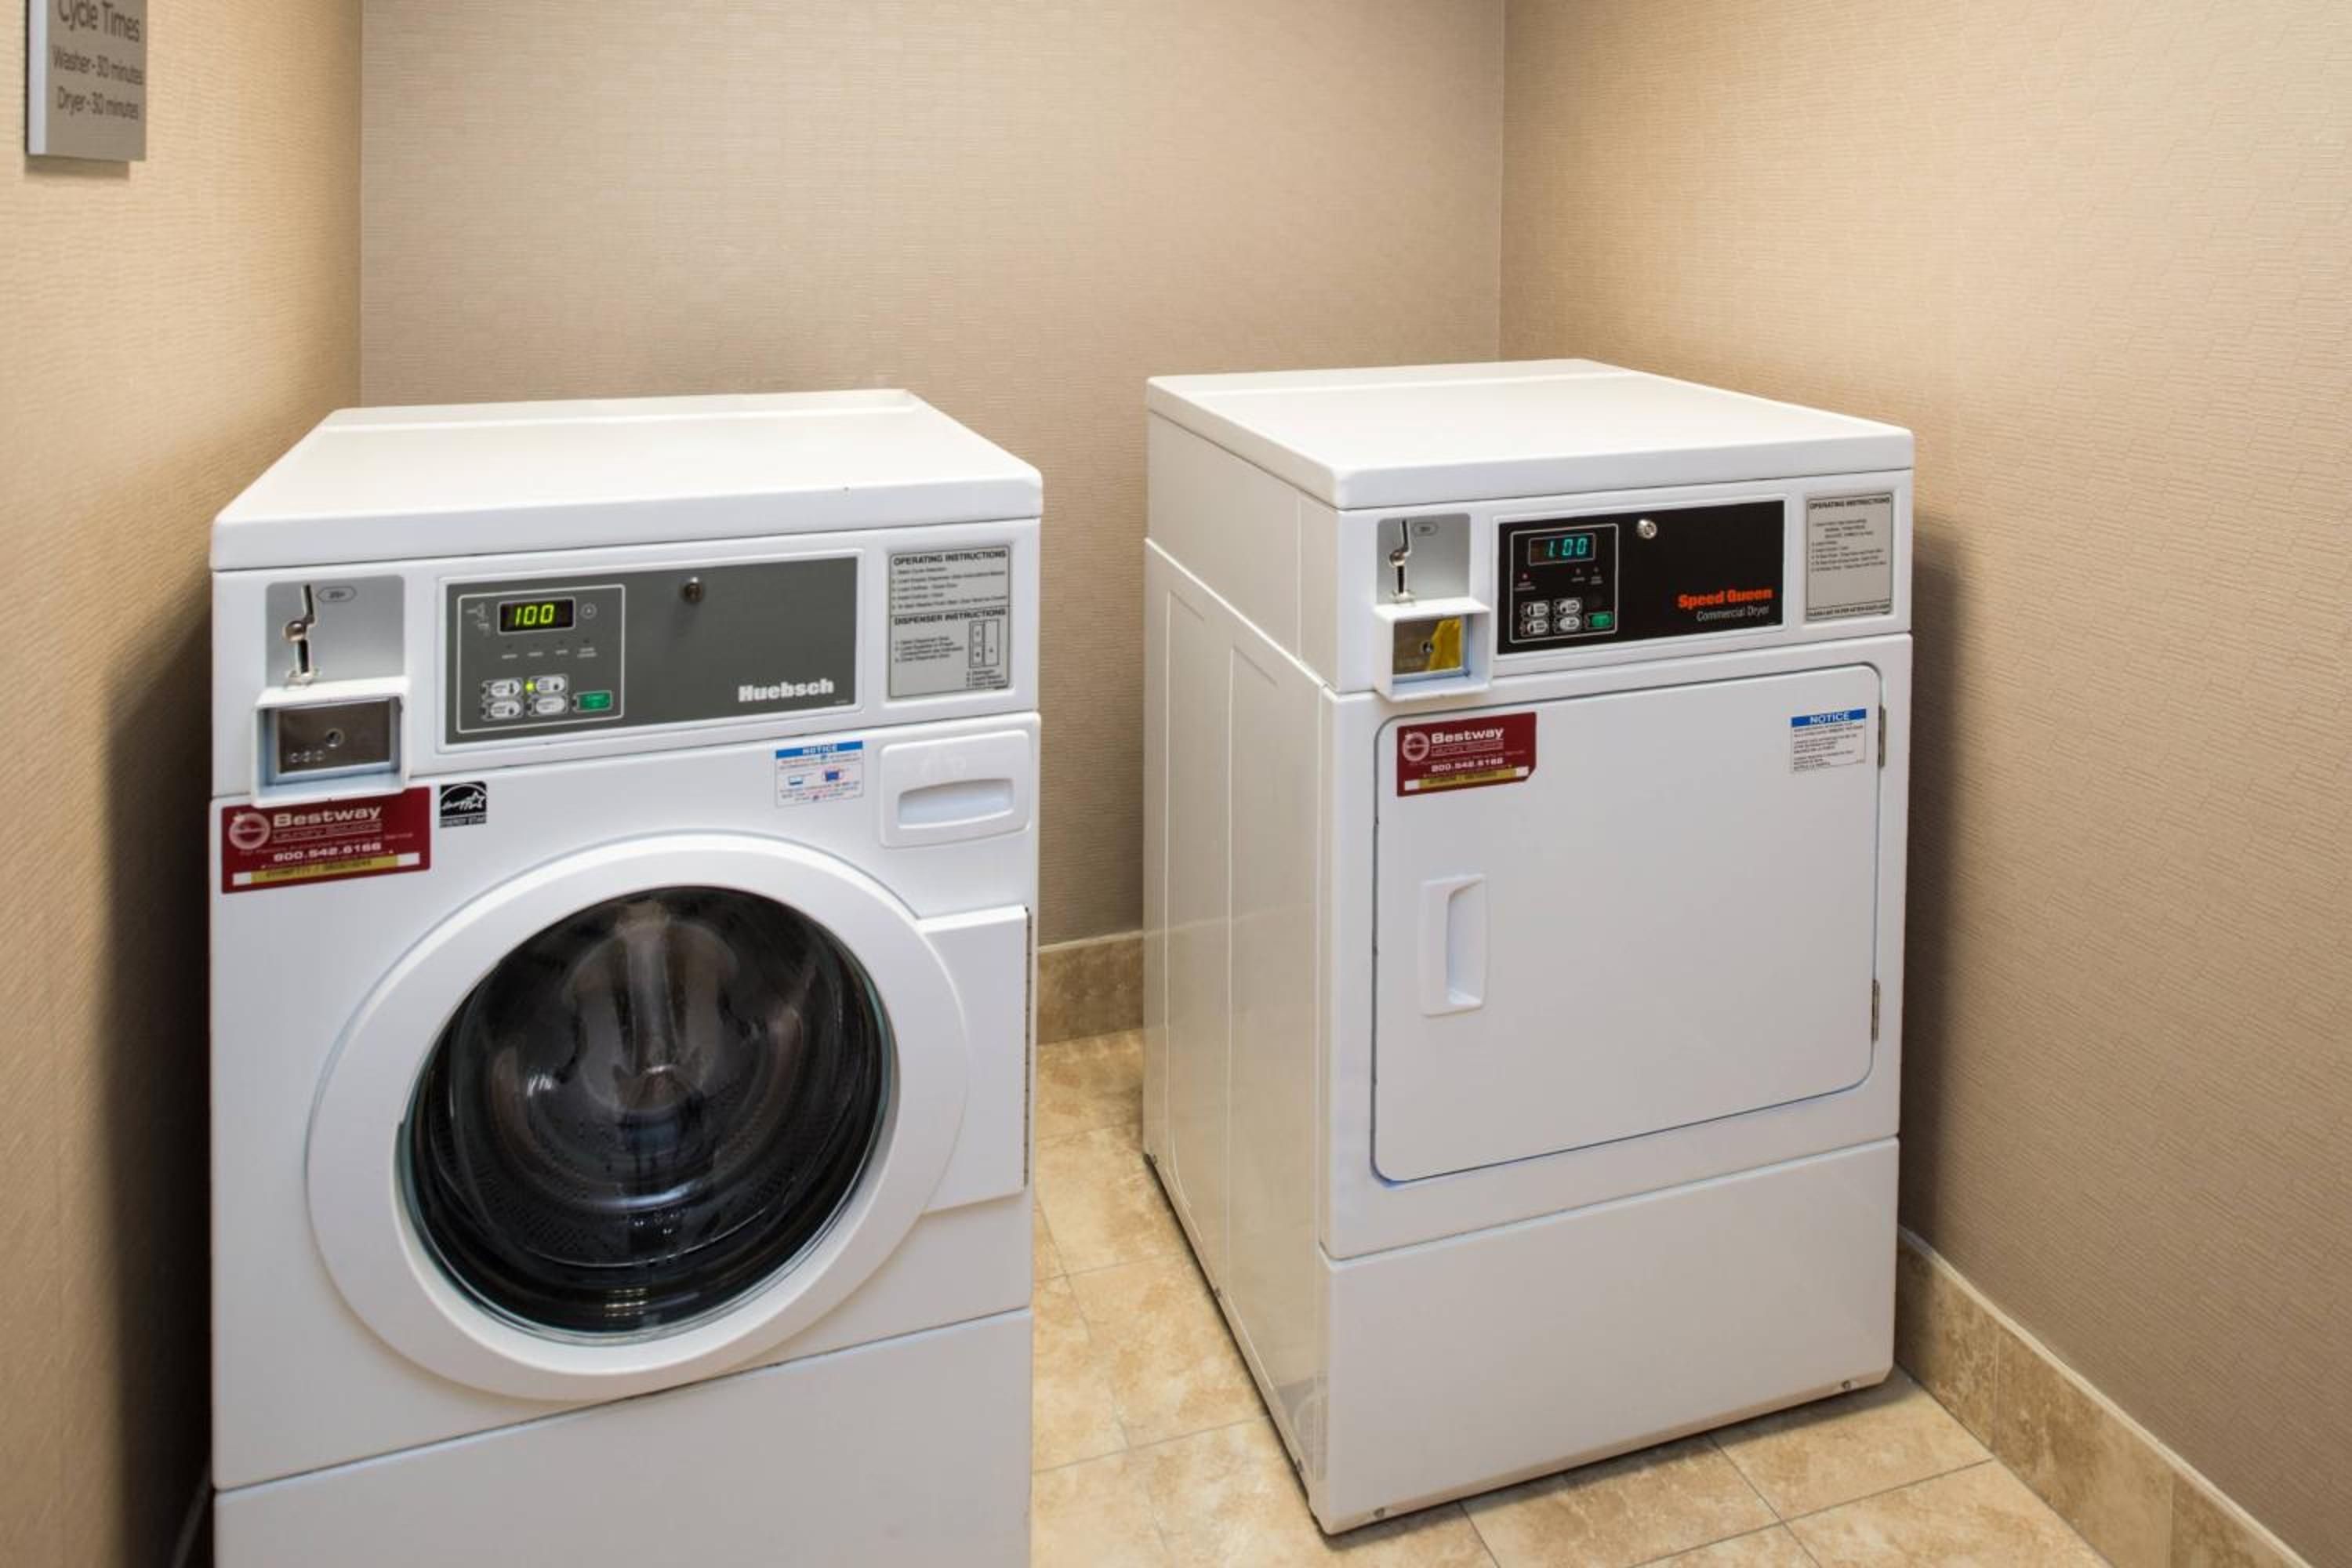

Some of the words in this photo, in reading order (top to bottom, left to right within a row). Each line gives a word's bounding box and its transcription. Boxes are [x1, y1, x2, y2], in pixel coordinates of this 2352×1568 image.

[57, 0, 98, 32] Cycle
[102, 0, 140, 42] Times
[1809, 500, 1845, 510] OPERATING
[893, 554, 943, 566] OPERATING
[945, 550, 1006, 562] INSTRUCTIONS
[1679, 590, 1725, 610] Speed
[1727, 589, 1773, 603] Queen
[514, 603, 555, 627] 100
[894, 614, 942, 626] DISPENSER
[945, 608, 1006, 621] INSTRUCTIONS
[1696, 607, 1745, 622] Commercial
[1747, 604, 1769, 616] Dryer
[738, 677, 835, 702] Huebsch
[1809, 710, 1849, 724] NOTICE
[1431, 728, 1504, 744] Bestway
[274, 806, 382, 827] Bestway
